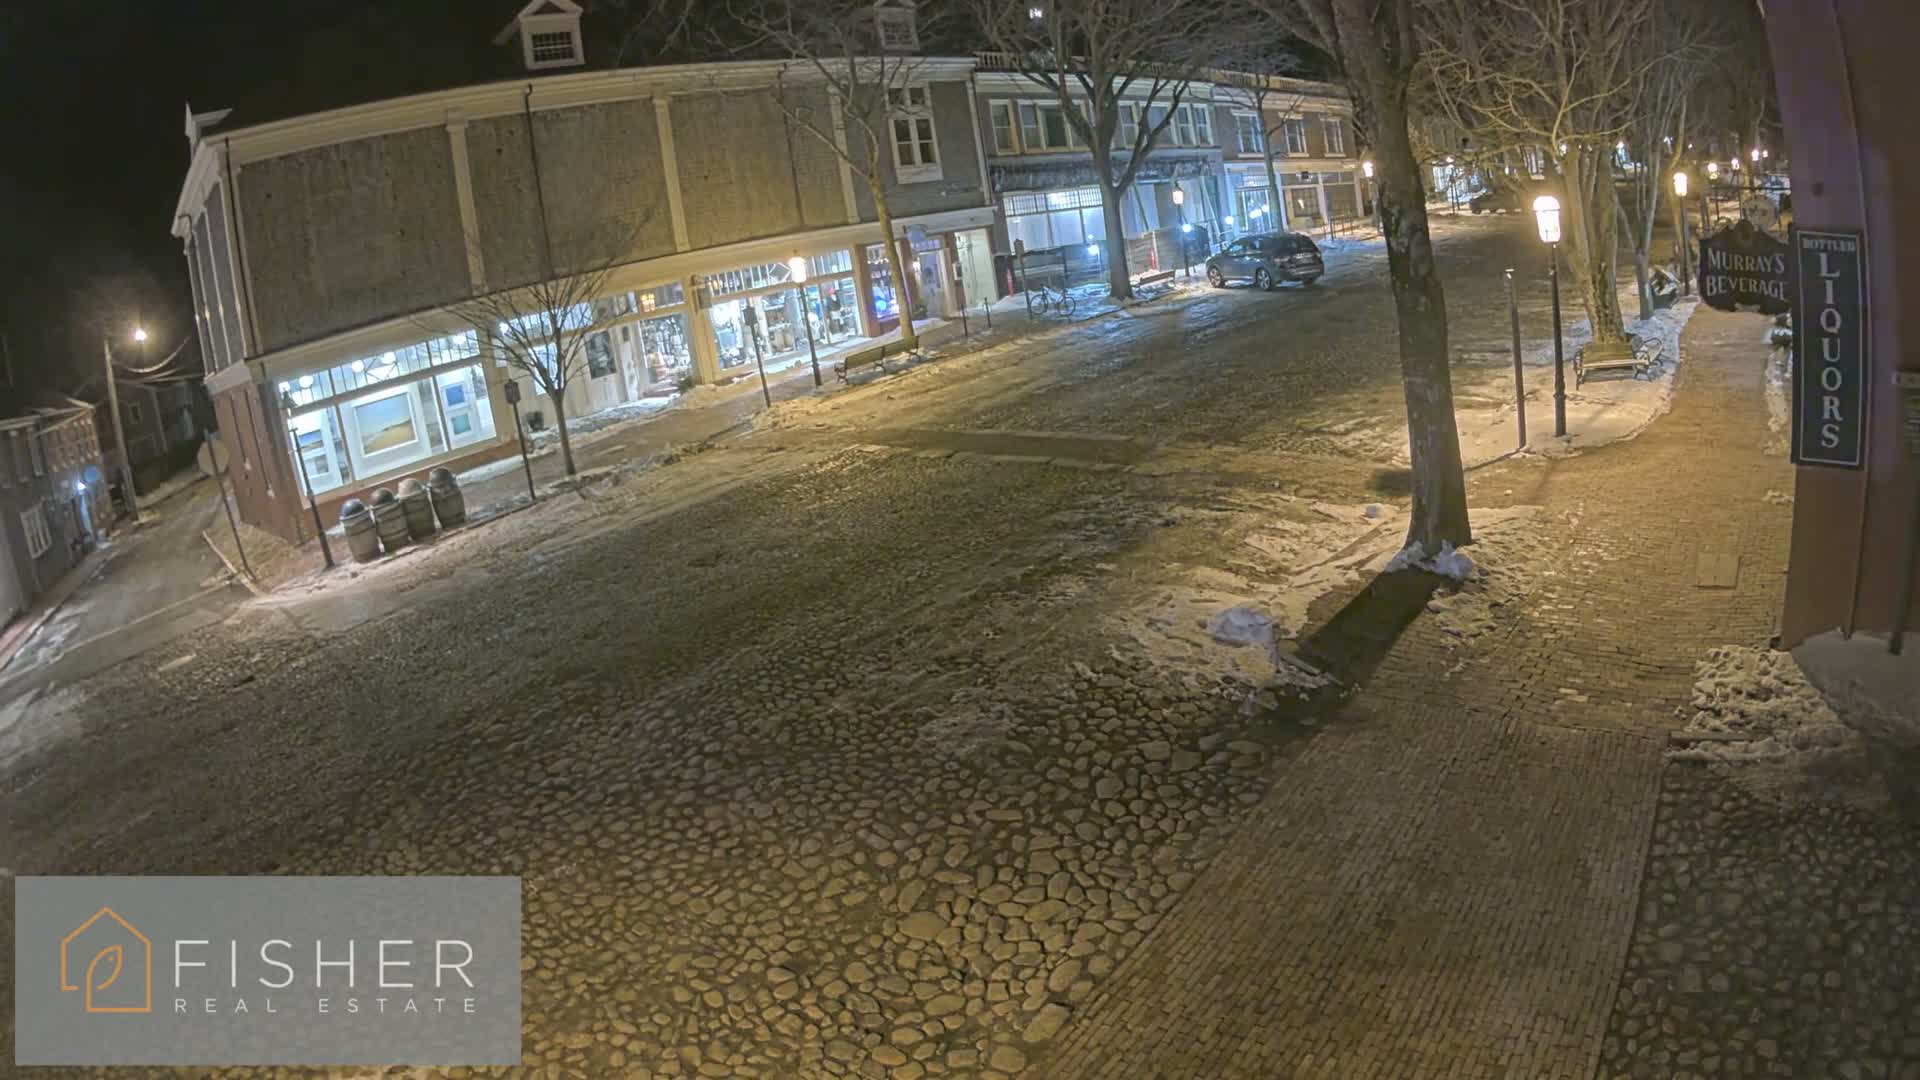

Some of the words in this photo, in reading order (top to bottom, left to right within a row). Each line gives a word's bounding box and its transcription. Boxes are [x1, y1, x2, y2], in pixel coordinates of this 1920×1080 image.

[1802, 238, 1856, 252] BOTTLED
[1707, 247, 1785, 273] MURRAY'S
[1818, 252, 1843, 448] LIQUORS
